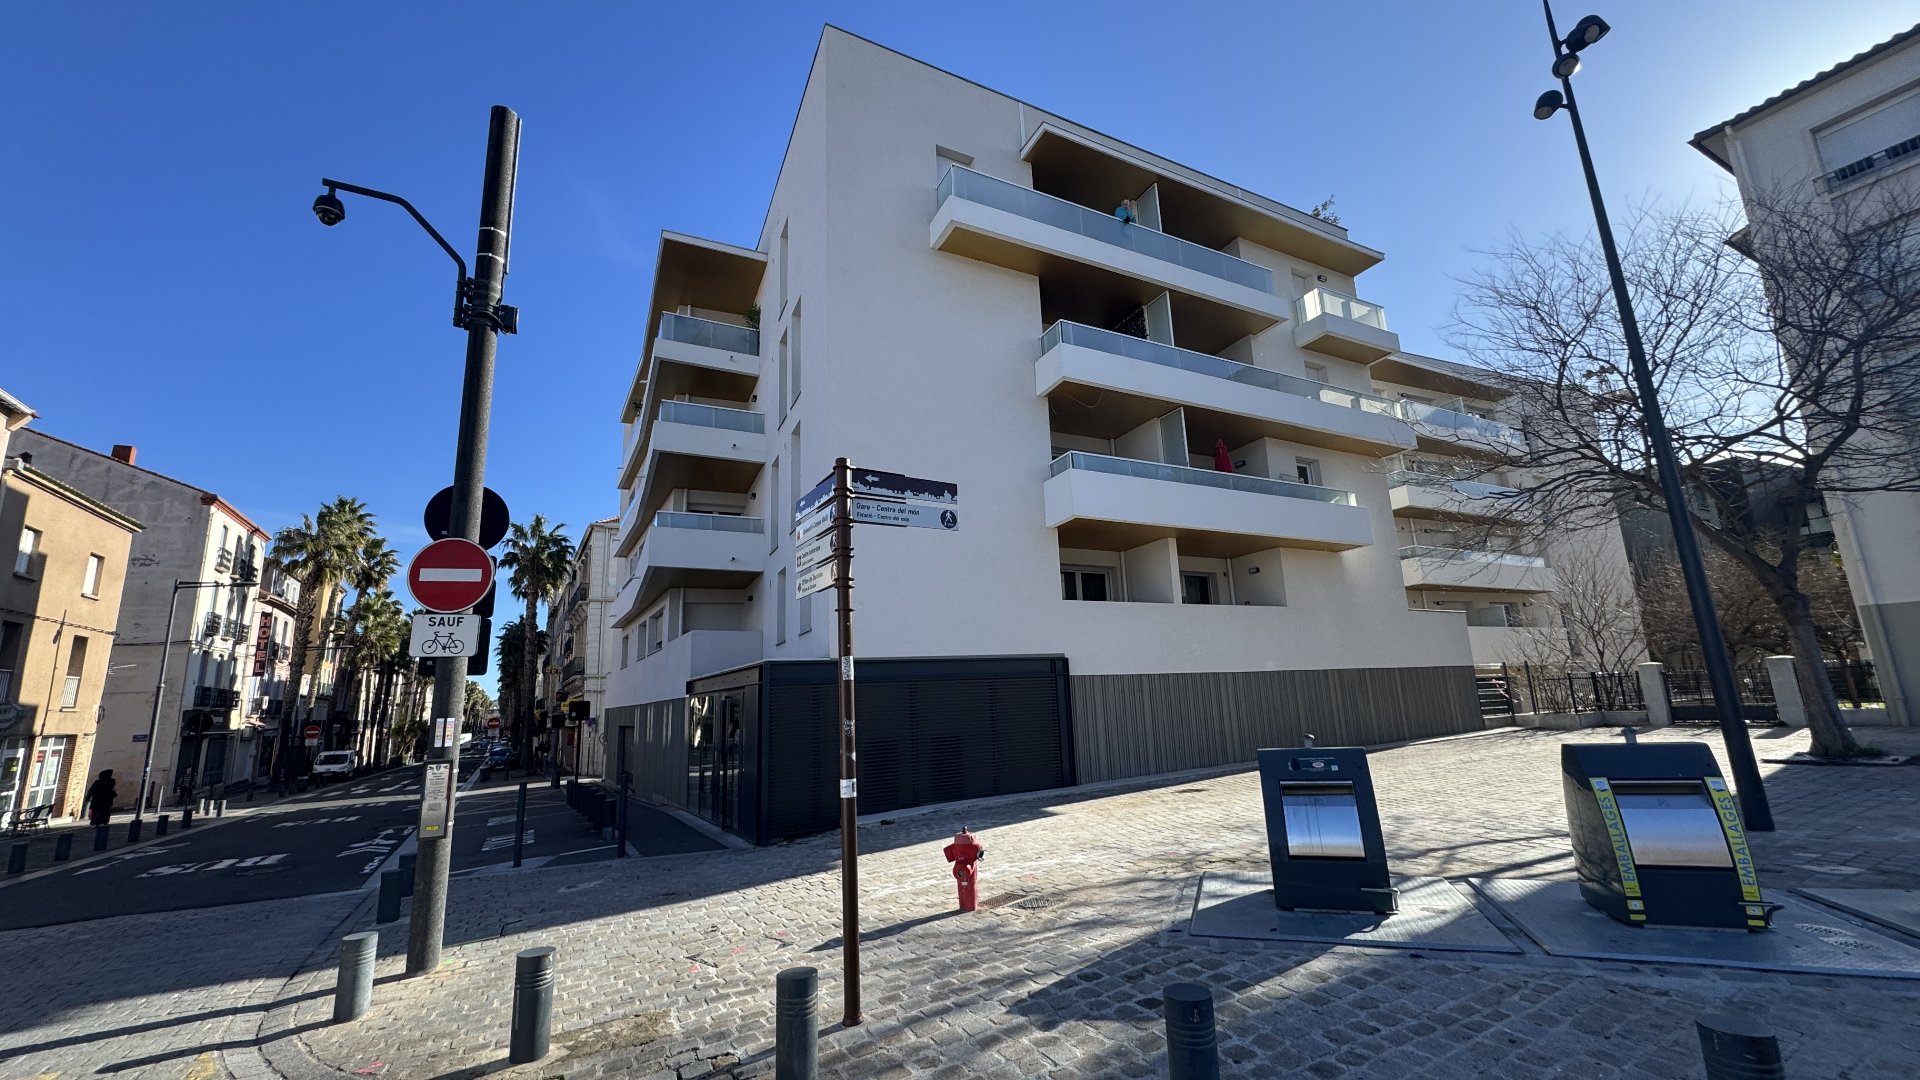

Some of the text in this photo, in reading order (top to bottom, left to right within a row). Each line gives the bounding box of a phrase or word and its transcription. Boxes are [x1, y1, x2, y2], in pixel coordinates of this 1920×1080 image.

[856, 502, 871, 510] Gare
[877, 504, 896, 513] Centre
[428, 616, 465, 627] SAUF
[254, 616, 272, 673] HOTEL
[1600, 796, 1636, 882] EMBALLAGES
[1718, 796, 1757, 886] EMBALLAGES
[133, 852, 291, 879] BUS
